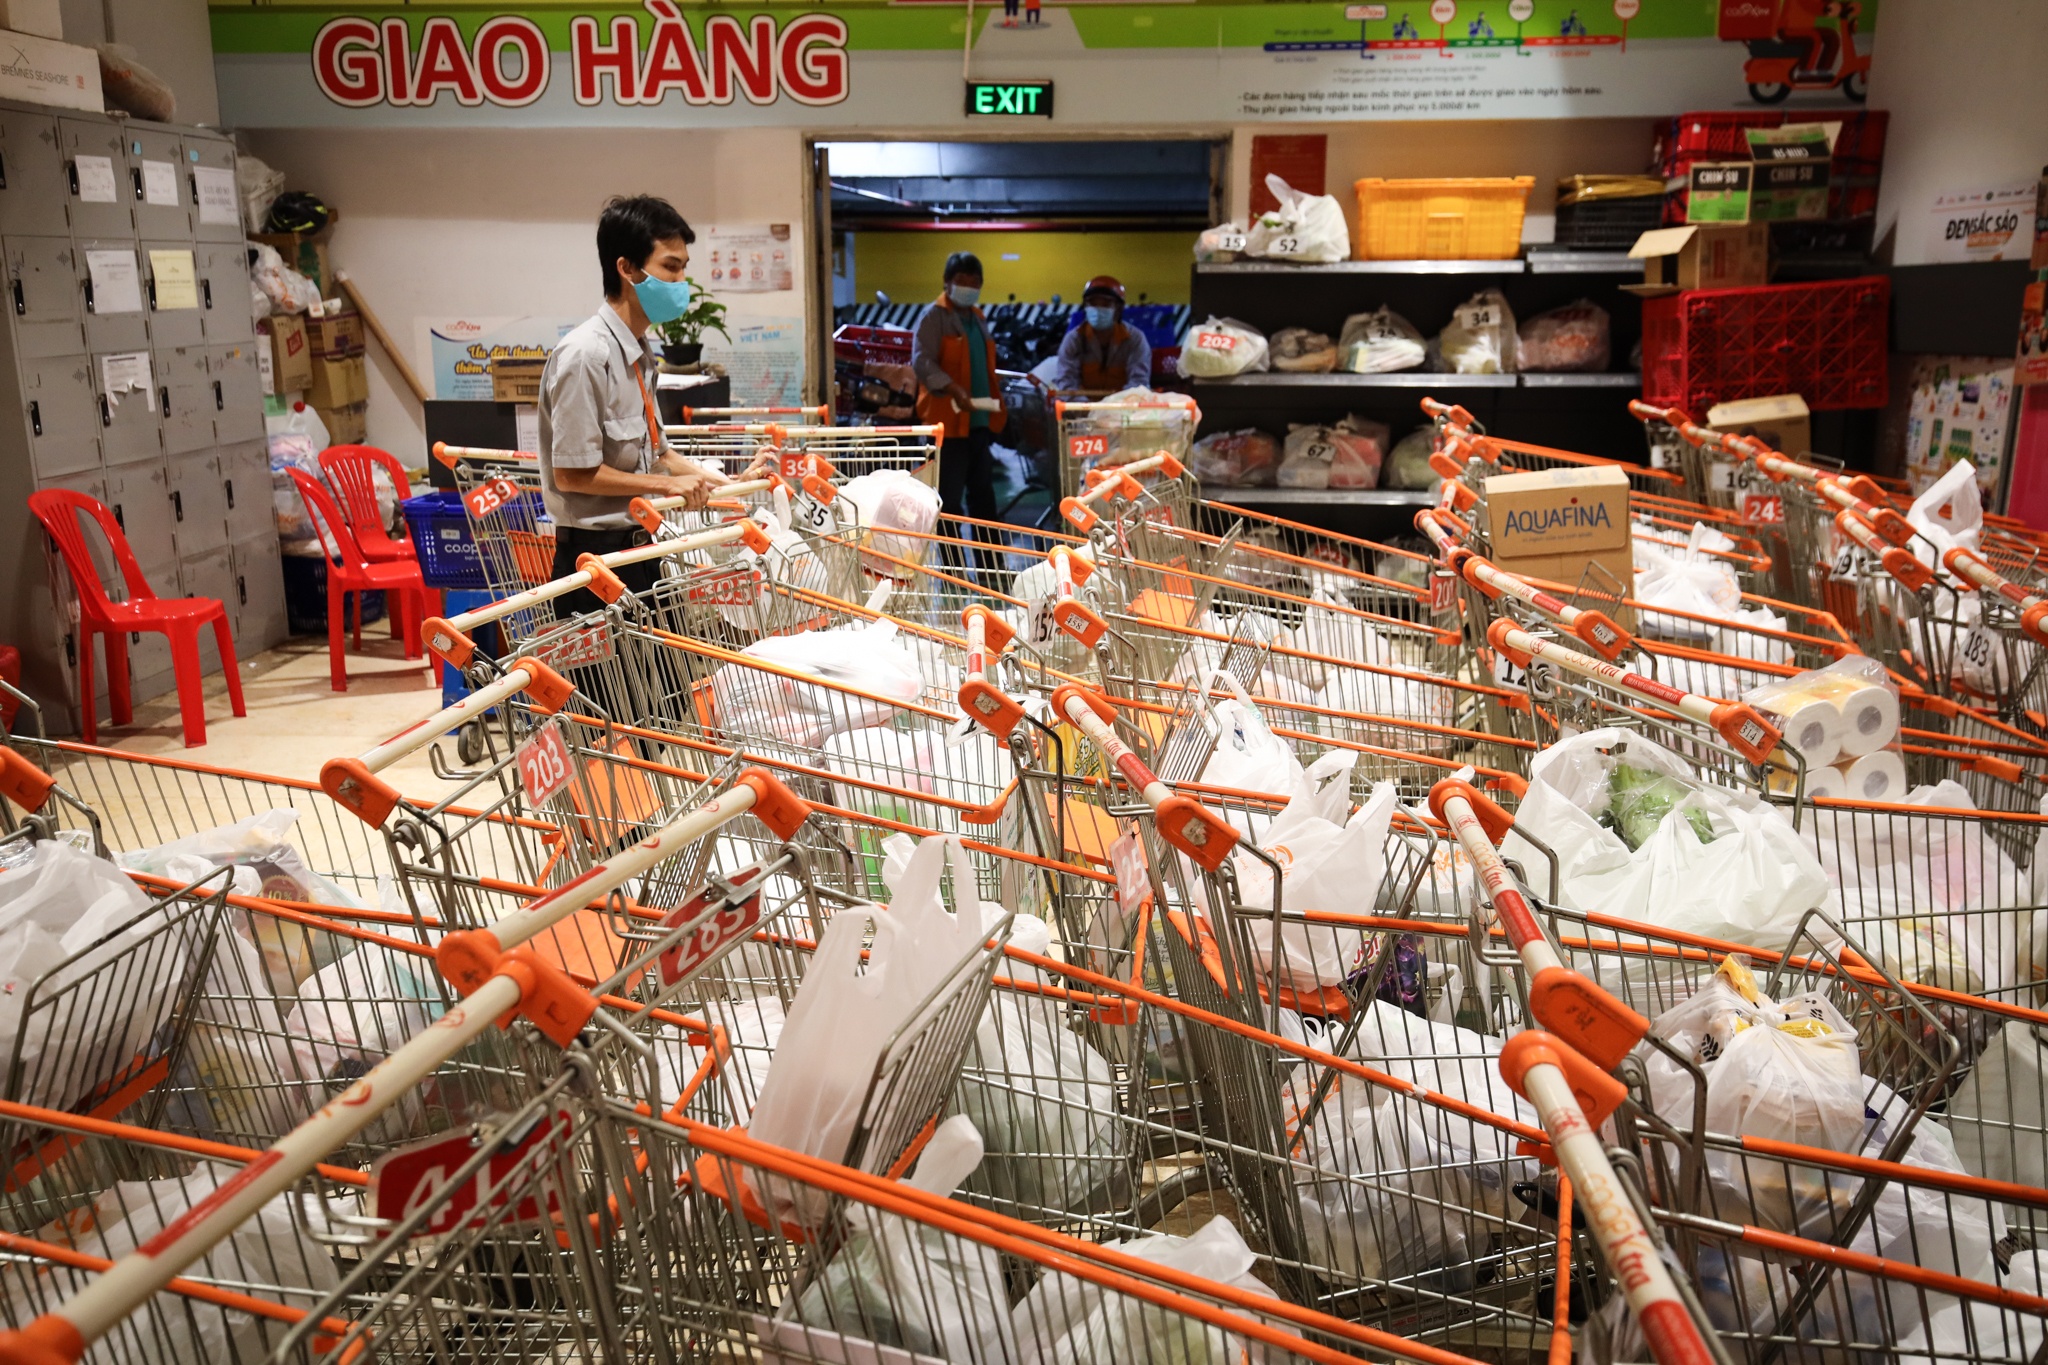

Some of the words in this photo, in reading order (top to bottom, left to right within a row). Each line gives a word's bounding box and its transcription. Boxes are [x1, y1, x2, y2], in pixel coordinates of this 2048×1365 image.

[312, 16, 551, 108] GIAO
[571, 0, 848, 107] HÀNG
[0, 64, 35, 80] BREMNES
[35, 70, 69, 86] SEASHORE
[976, 86, 1043, 114] EXIT
[1225, 236, 1241, 248] 15
[1279, 239, 1298, 252] 52
[1471, 311, 1490, 326] 34
[1202, 334, 1232, 349] 202
[1074, 438, 1105, 456] 274
[1308, 445, 1326, 458] 67
[1726, 471, 1749, 489] 16
[472, 480, 512, 515] 259
[1503, 501, 1611, 538] AQUAFINA
[1964, 631, 1990, 667] 183
[1740, 725, 1758, 741] 314
[527, 740, 565, 799] 203
